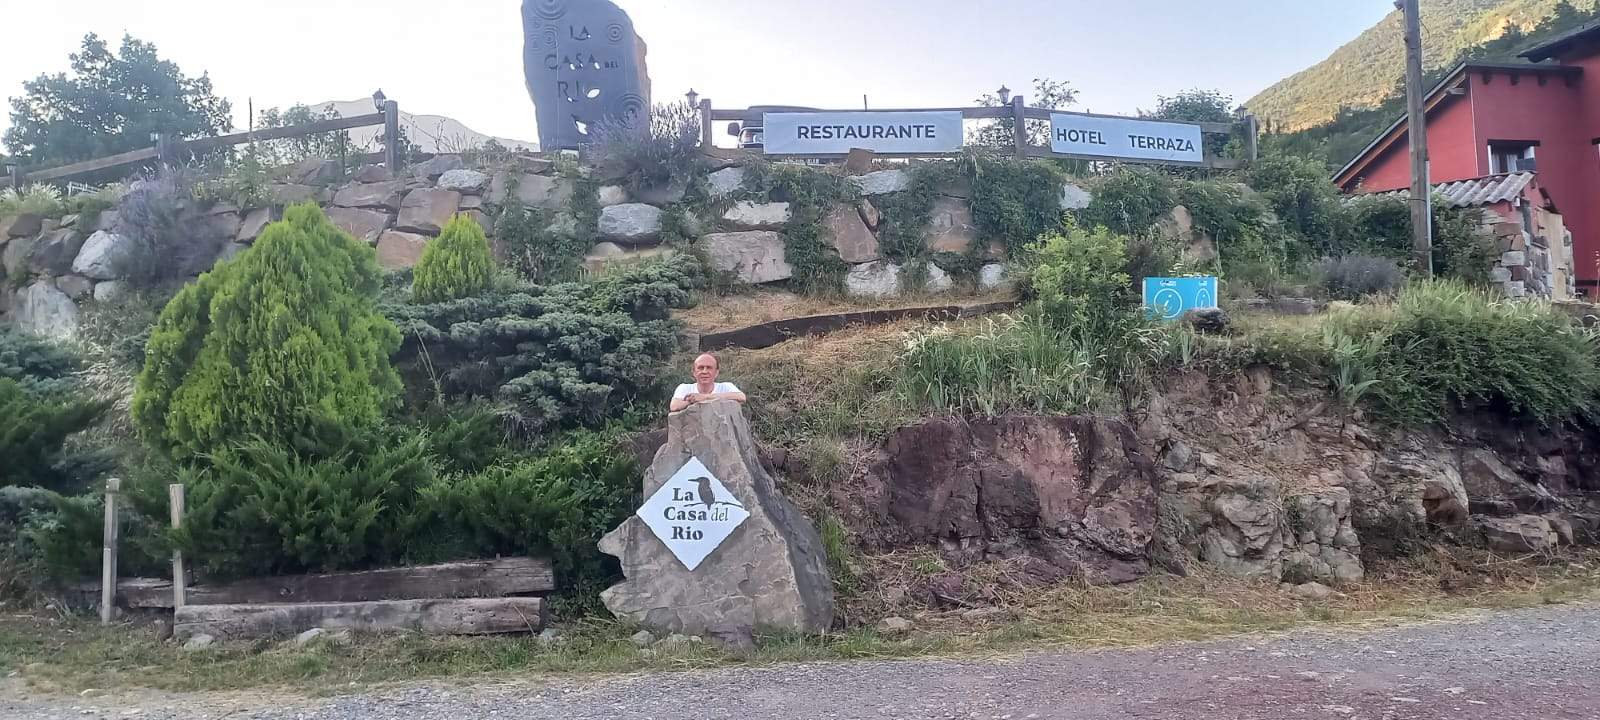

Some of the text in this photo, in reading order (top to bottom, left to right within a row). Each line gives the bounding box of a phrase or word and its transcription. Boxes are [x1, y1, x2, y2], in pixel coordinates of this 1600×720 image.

[570, 25, 591, 41] LA
[544, 53, 600, 70] CASA
[557, 80, 600, 102] RIO
[797, 124, 936, 140] RESTAURANTE
[1056, 128, 1195, 153] HOTEL TERRAZA
[671, 487, 694, 502] La
[663, 506, 729, 522] Casa del
[670, 525, 704, 541] Rio
